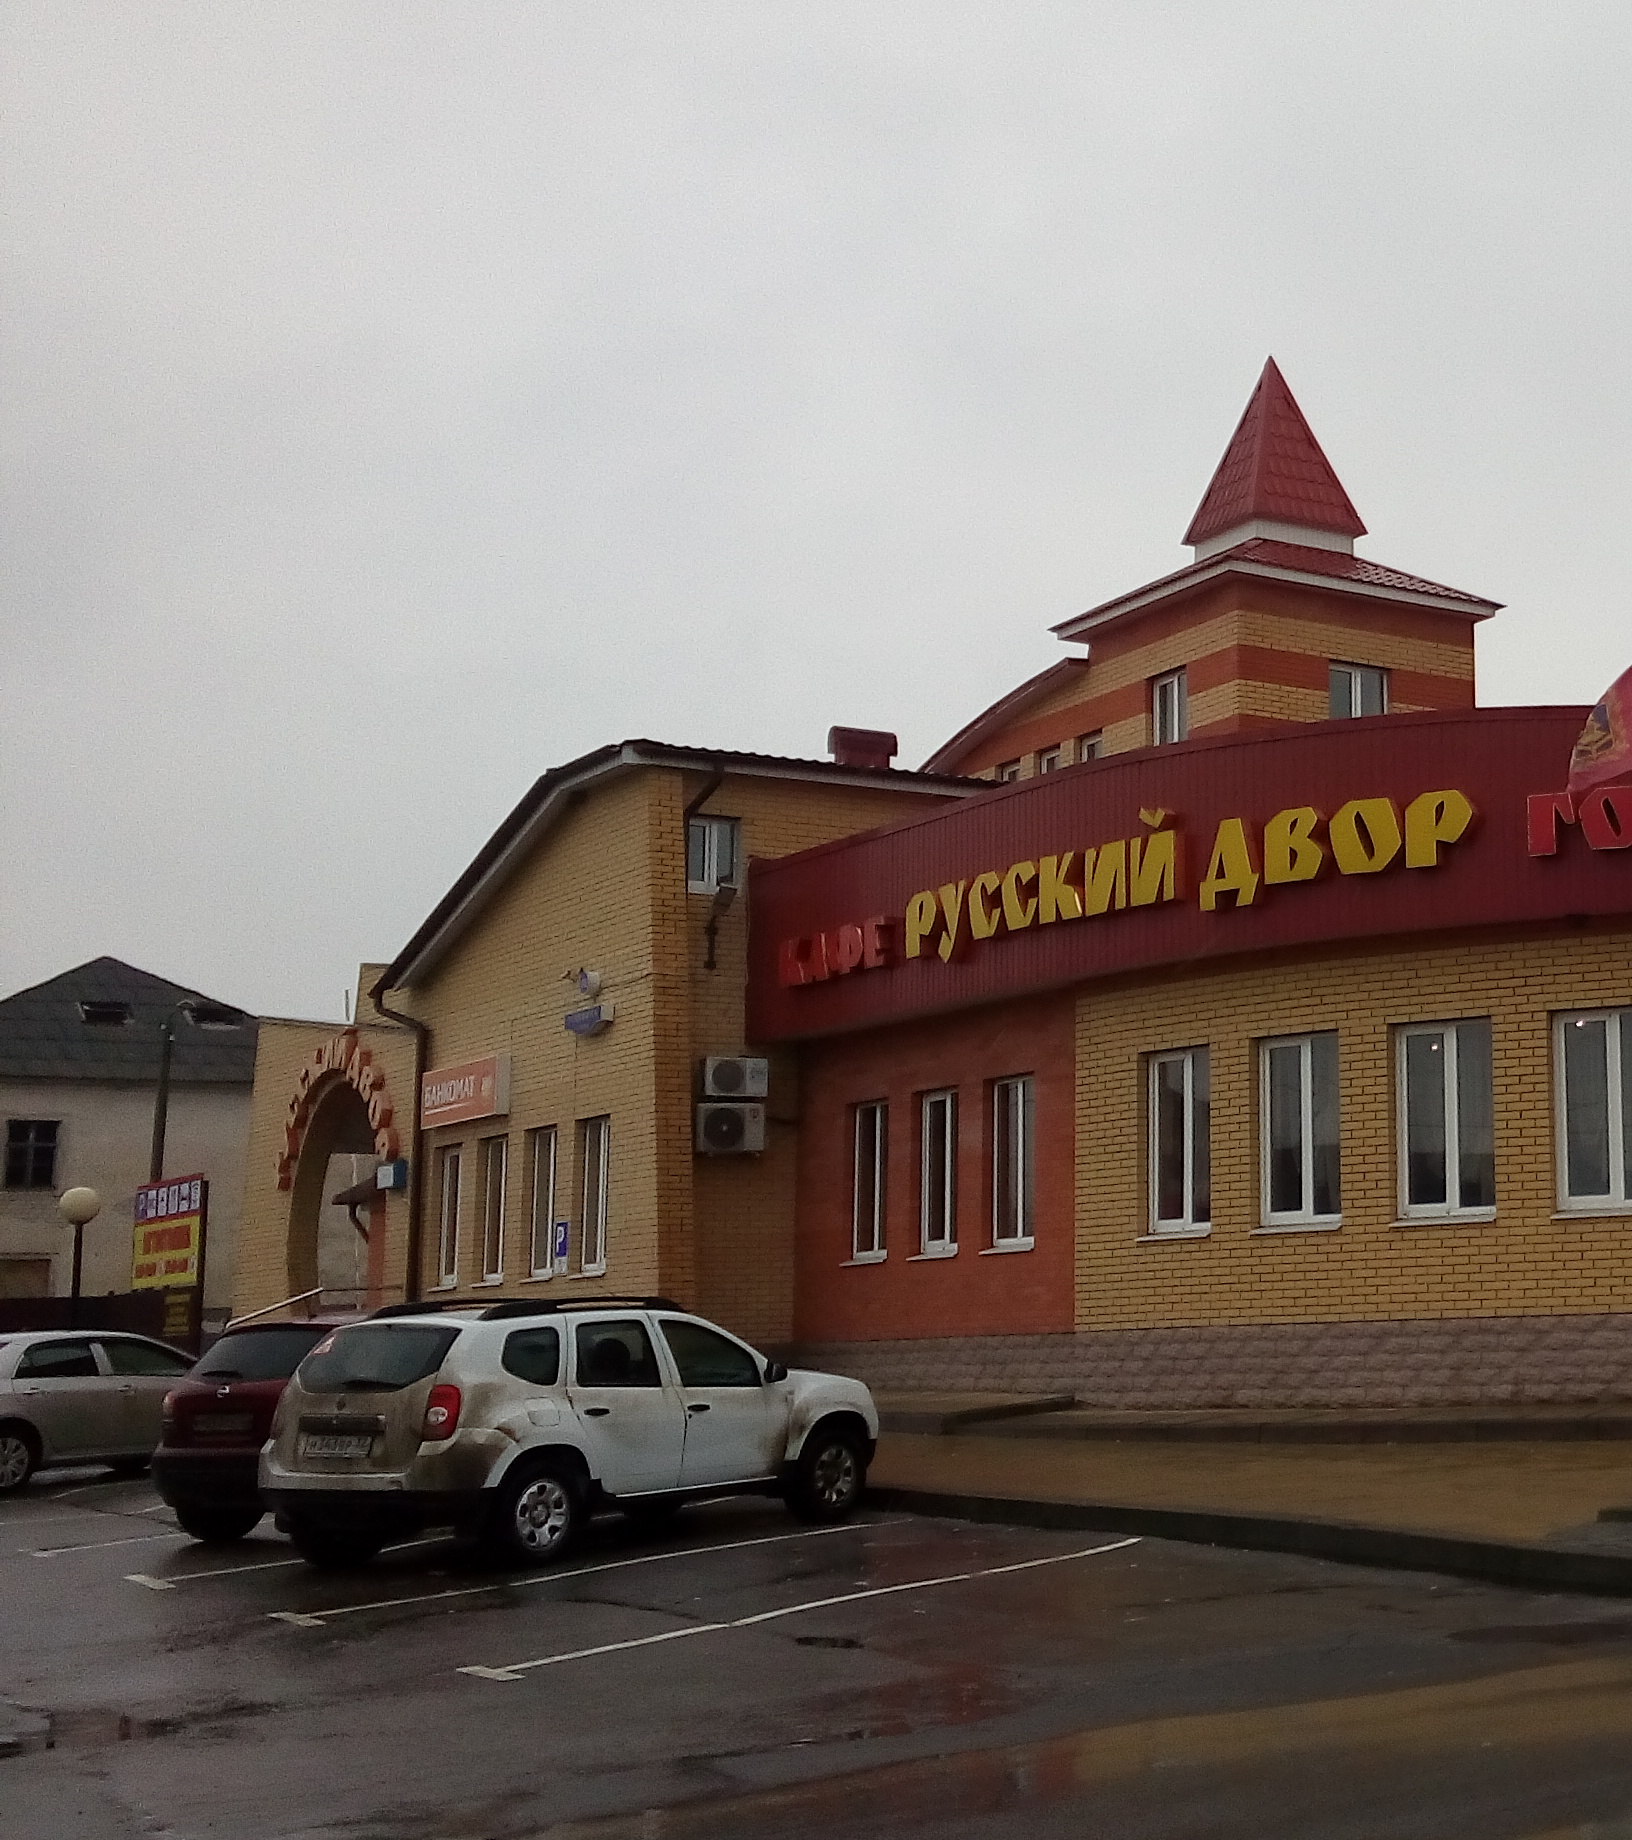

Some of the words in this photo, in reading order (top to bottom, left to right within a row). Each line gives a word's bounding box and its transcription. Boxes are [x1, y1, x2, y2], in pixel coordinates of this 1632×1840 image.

[778, 916, 890, 988] КАФЕ
[905, 807, 1180, 963] РУССКИЙ
[1200, 789, 1477, 912] ДВОР
[424, 1075, 475, 1108] БАНКОМАТ
[556, 1226, 565, 1254] P
